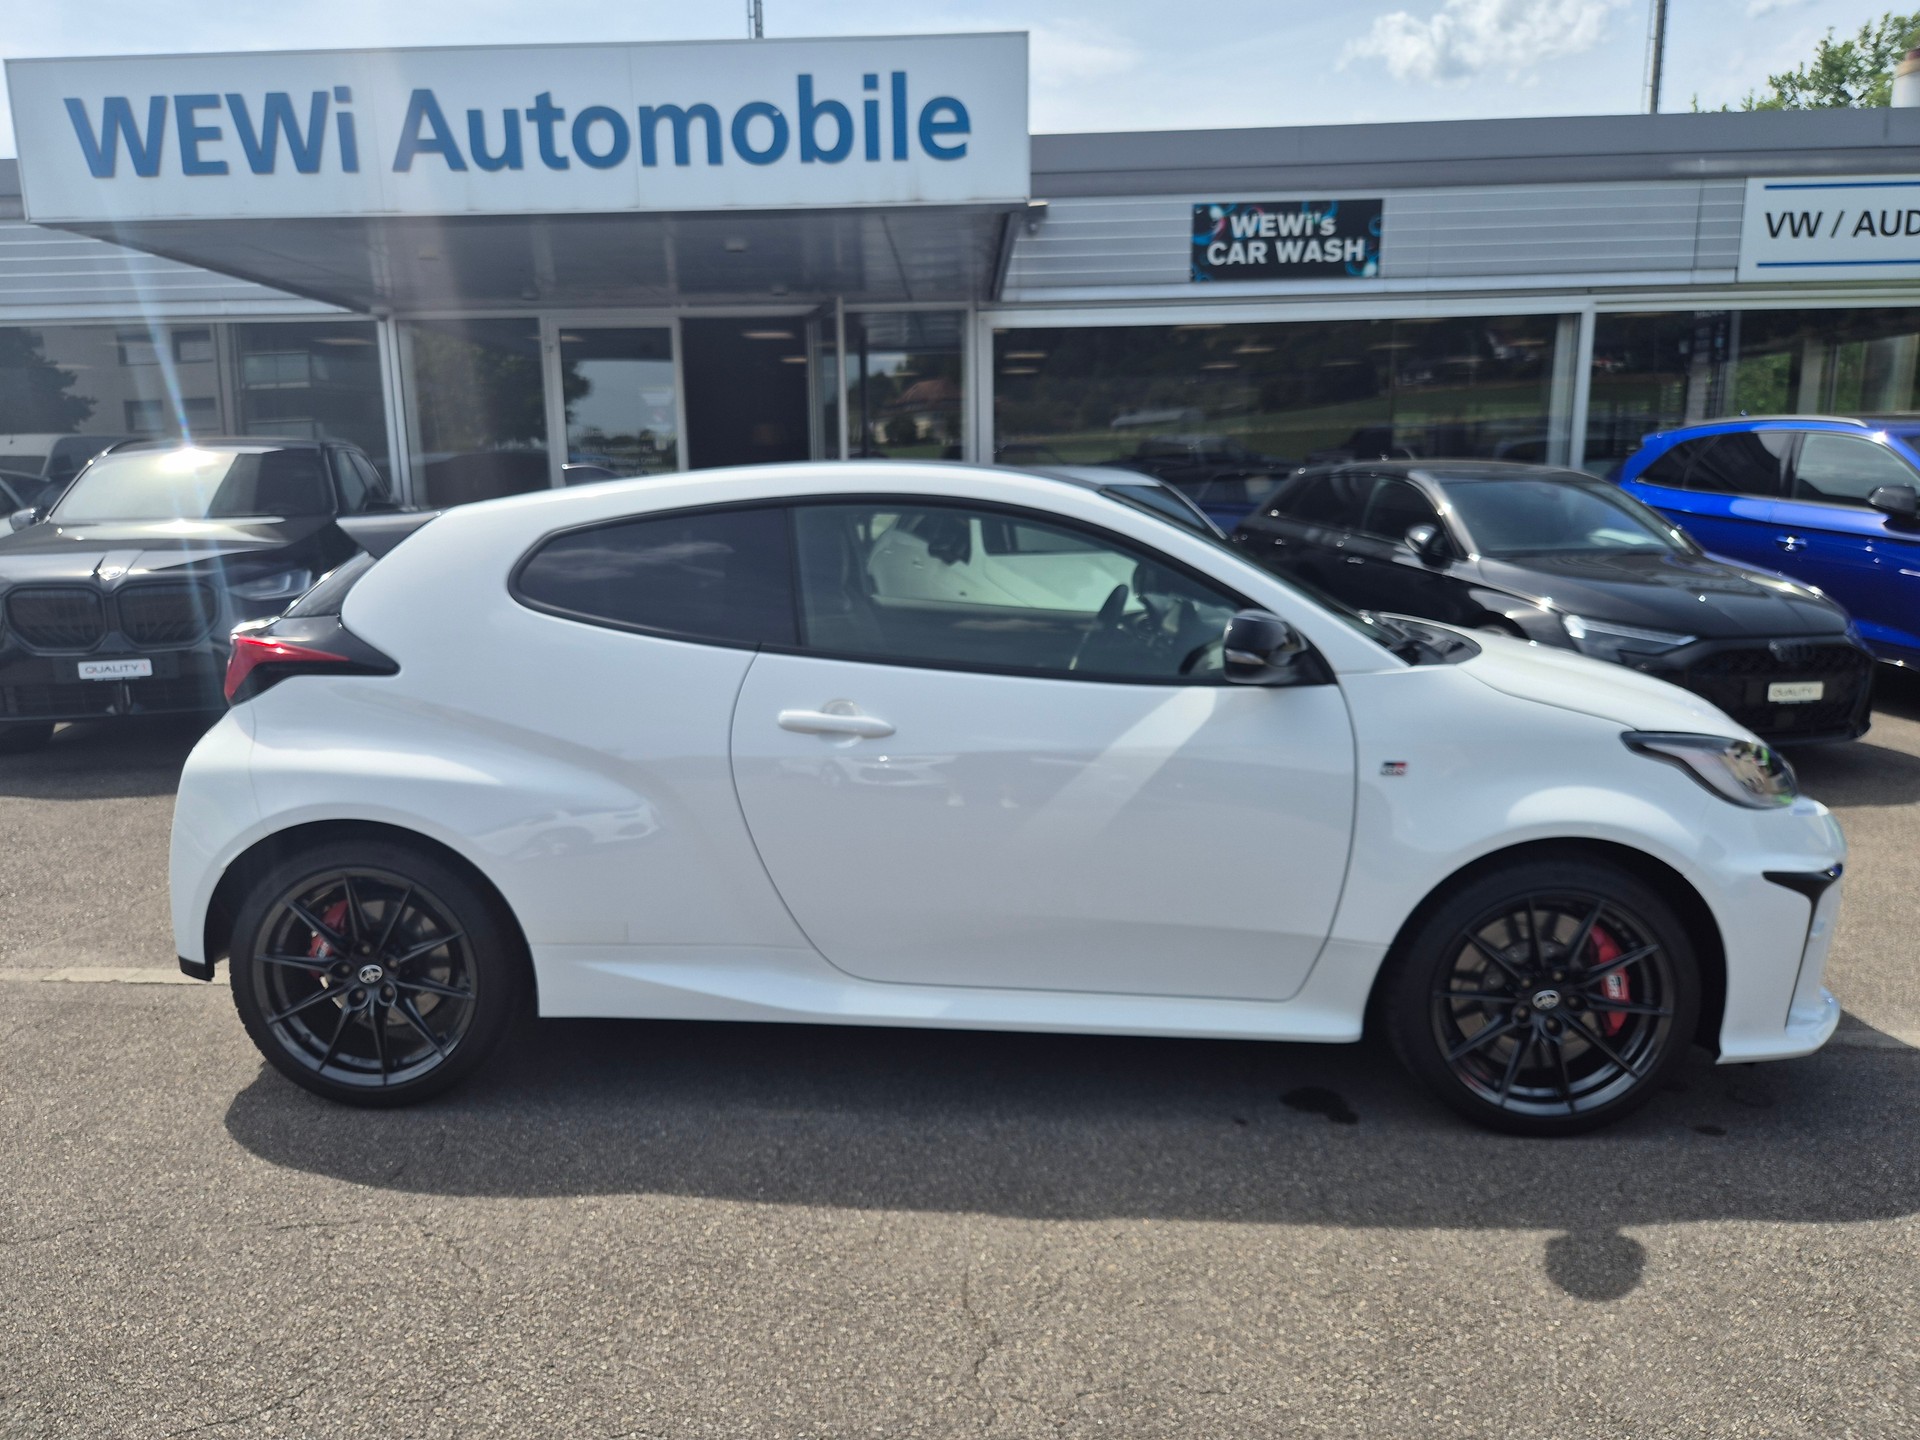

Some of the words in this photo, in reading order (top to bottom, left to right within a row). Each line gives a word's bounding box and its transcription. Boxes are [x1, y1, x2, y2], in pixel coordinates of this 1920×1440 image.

[64, 86, 359, 177] WEWi
[393, 71, 972, 172] Automobile
[1230, 213, 1336, 238] WEWi's
[1765, 211, 1823, 238] VW
[1207, 241, 1267, 266] CAR
[1275, 238, 1366, 263] WASH
[85, 664, 138, 674] QUALITY
